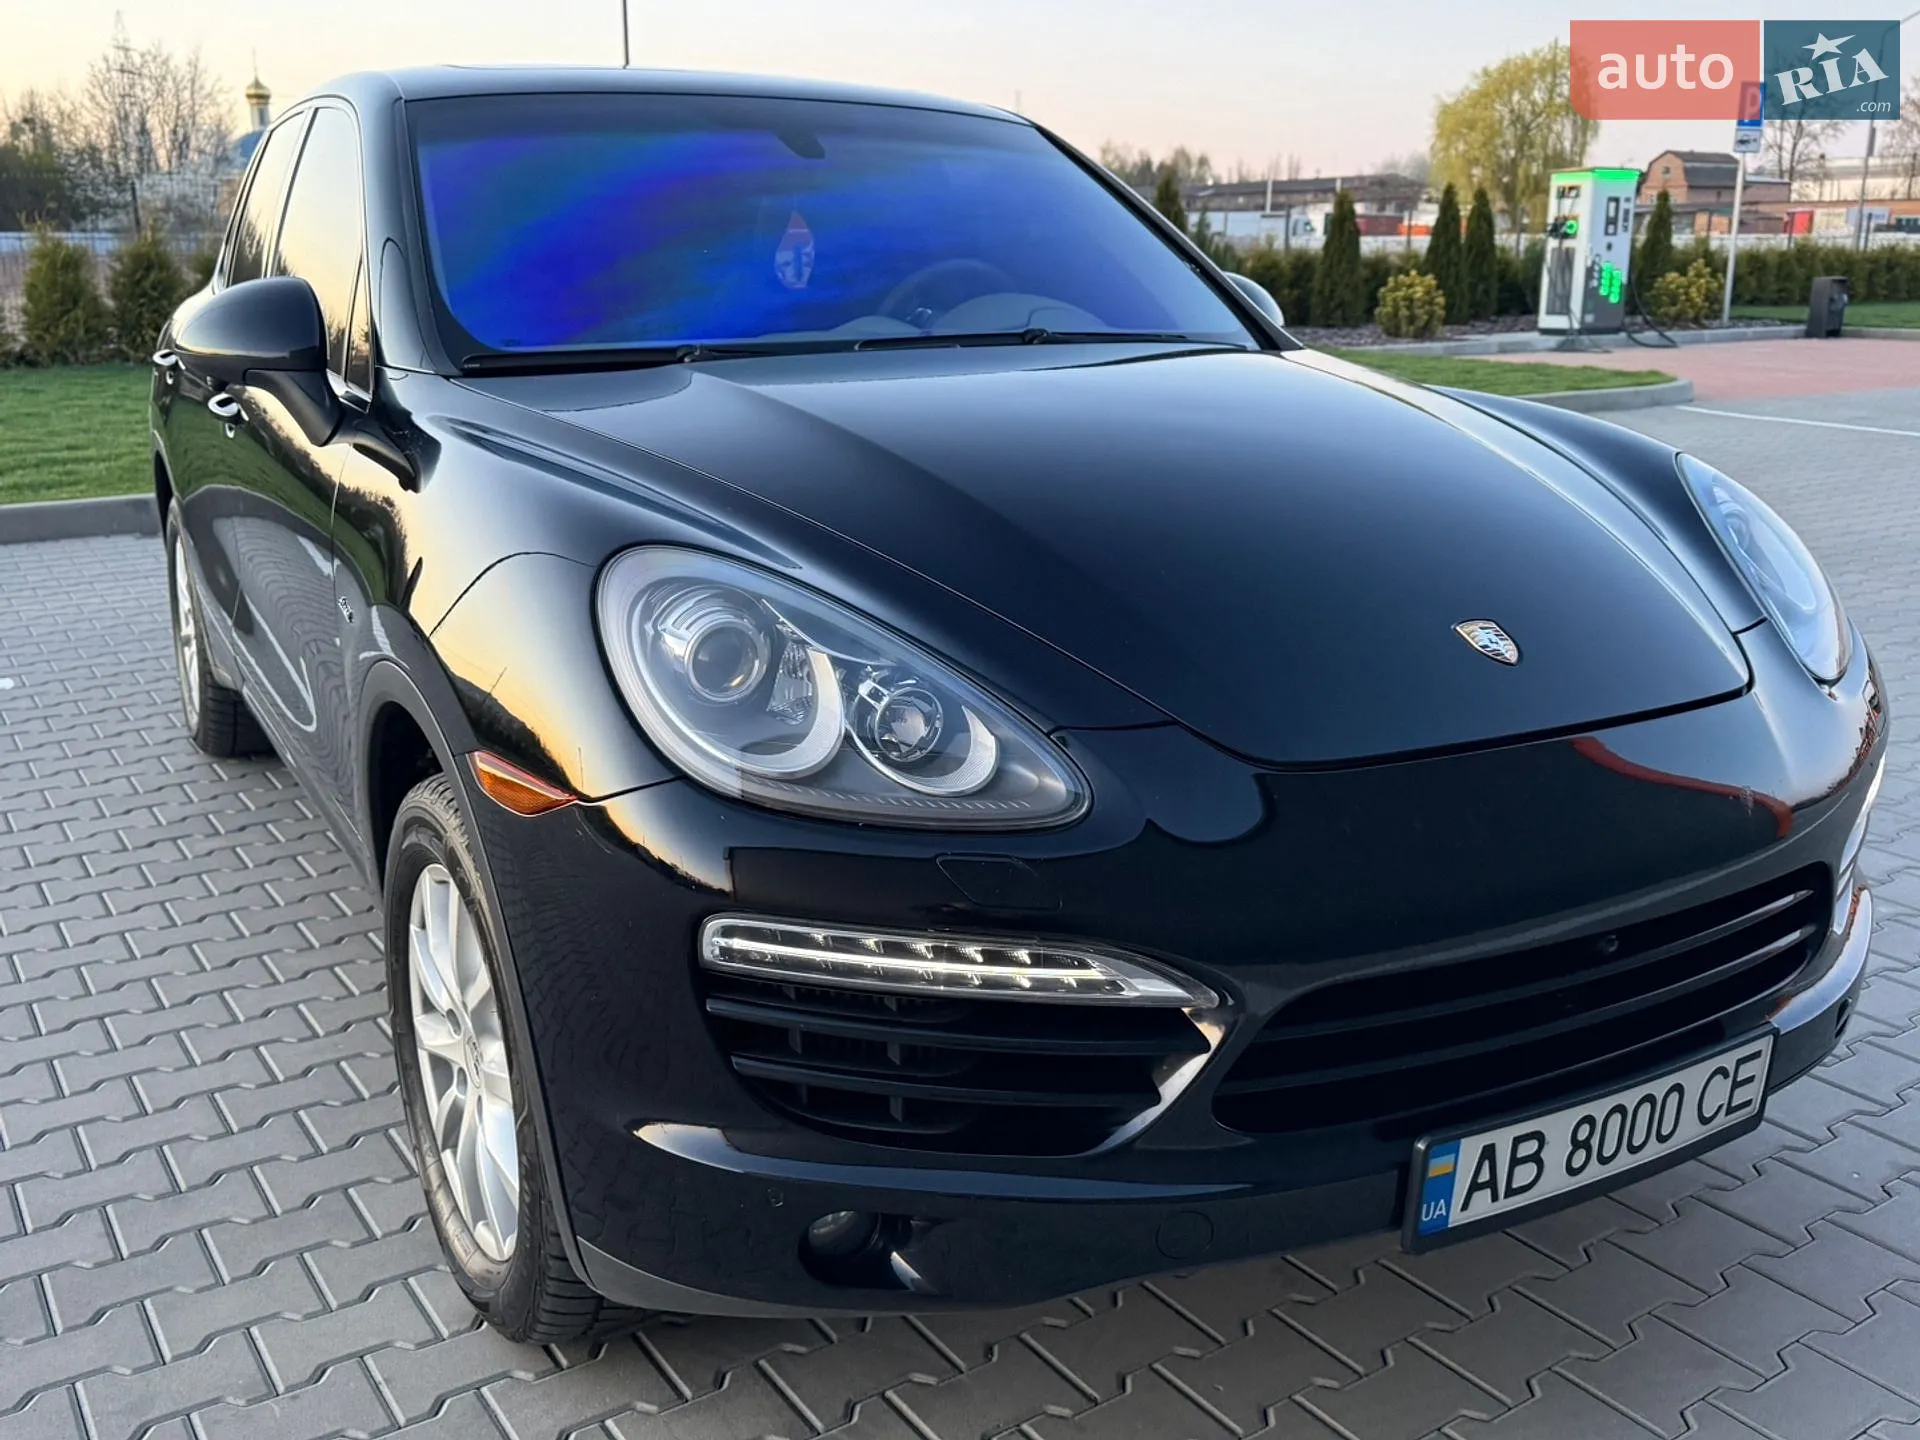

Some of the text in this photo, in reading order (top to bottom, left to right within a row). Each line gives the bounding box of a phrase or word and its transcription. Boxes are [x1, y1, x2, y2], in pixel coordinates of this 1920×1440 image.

[1460, 1049, 1762, 1213] AB 8000 CE
[1421, 1198, 1447, 1221] UA
